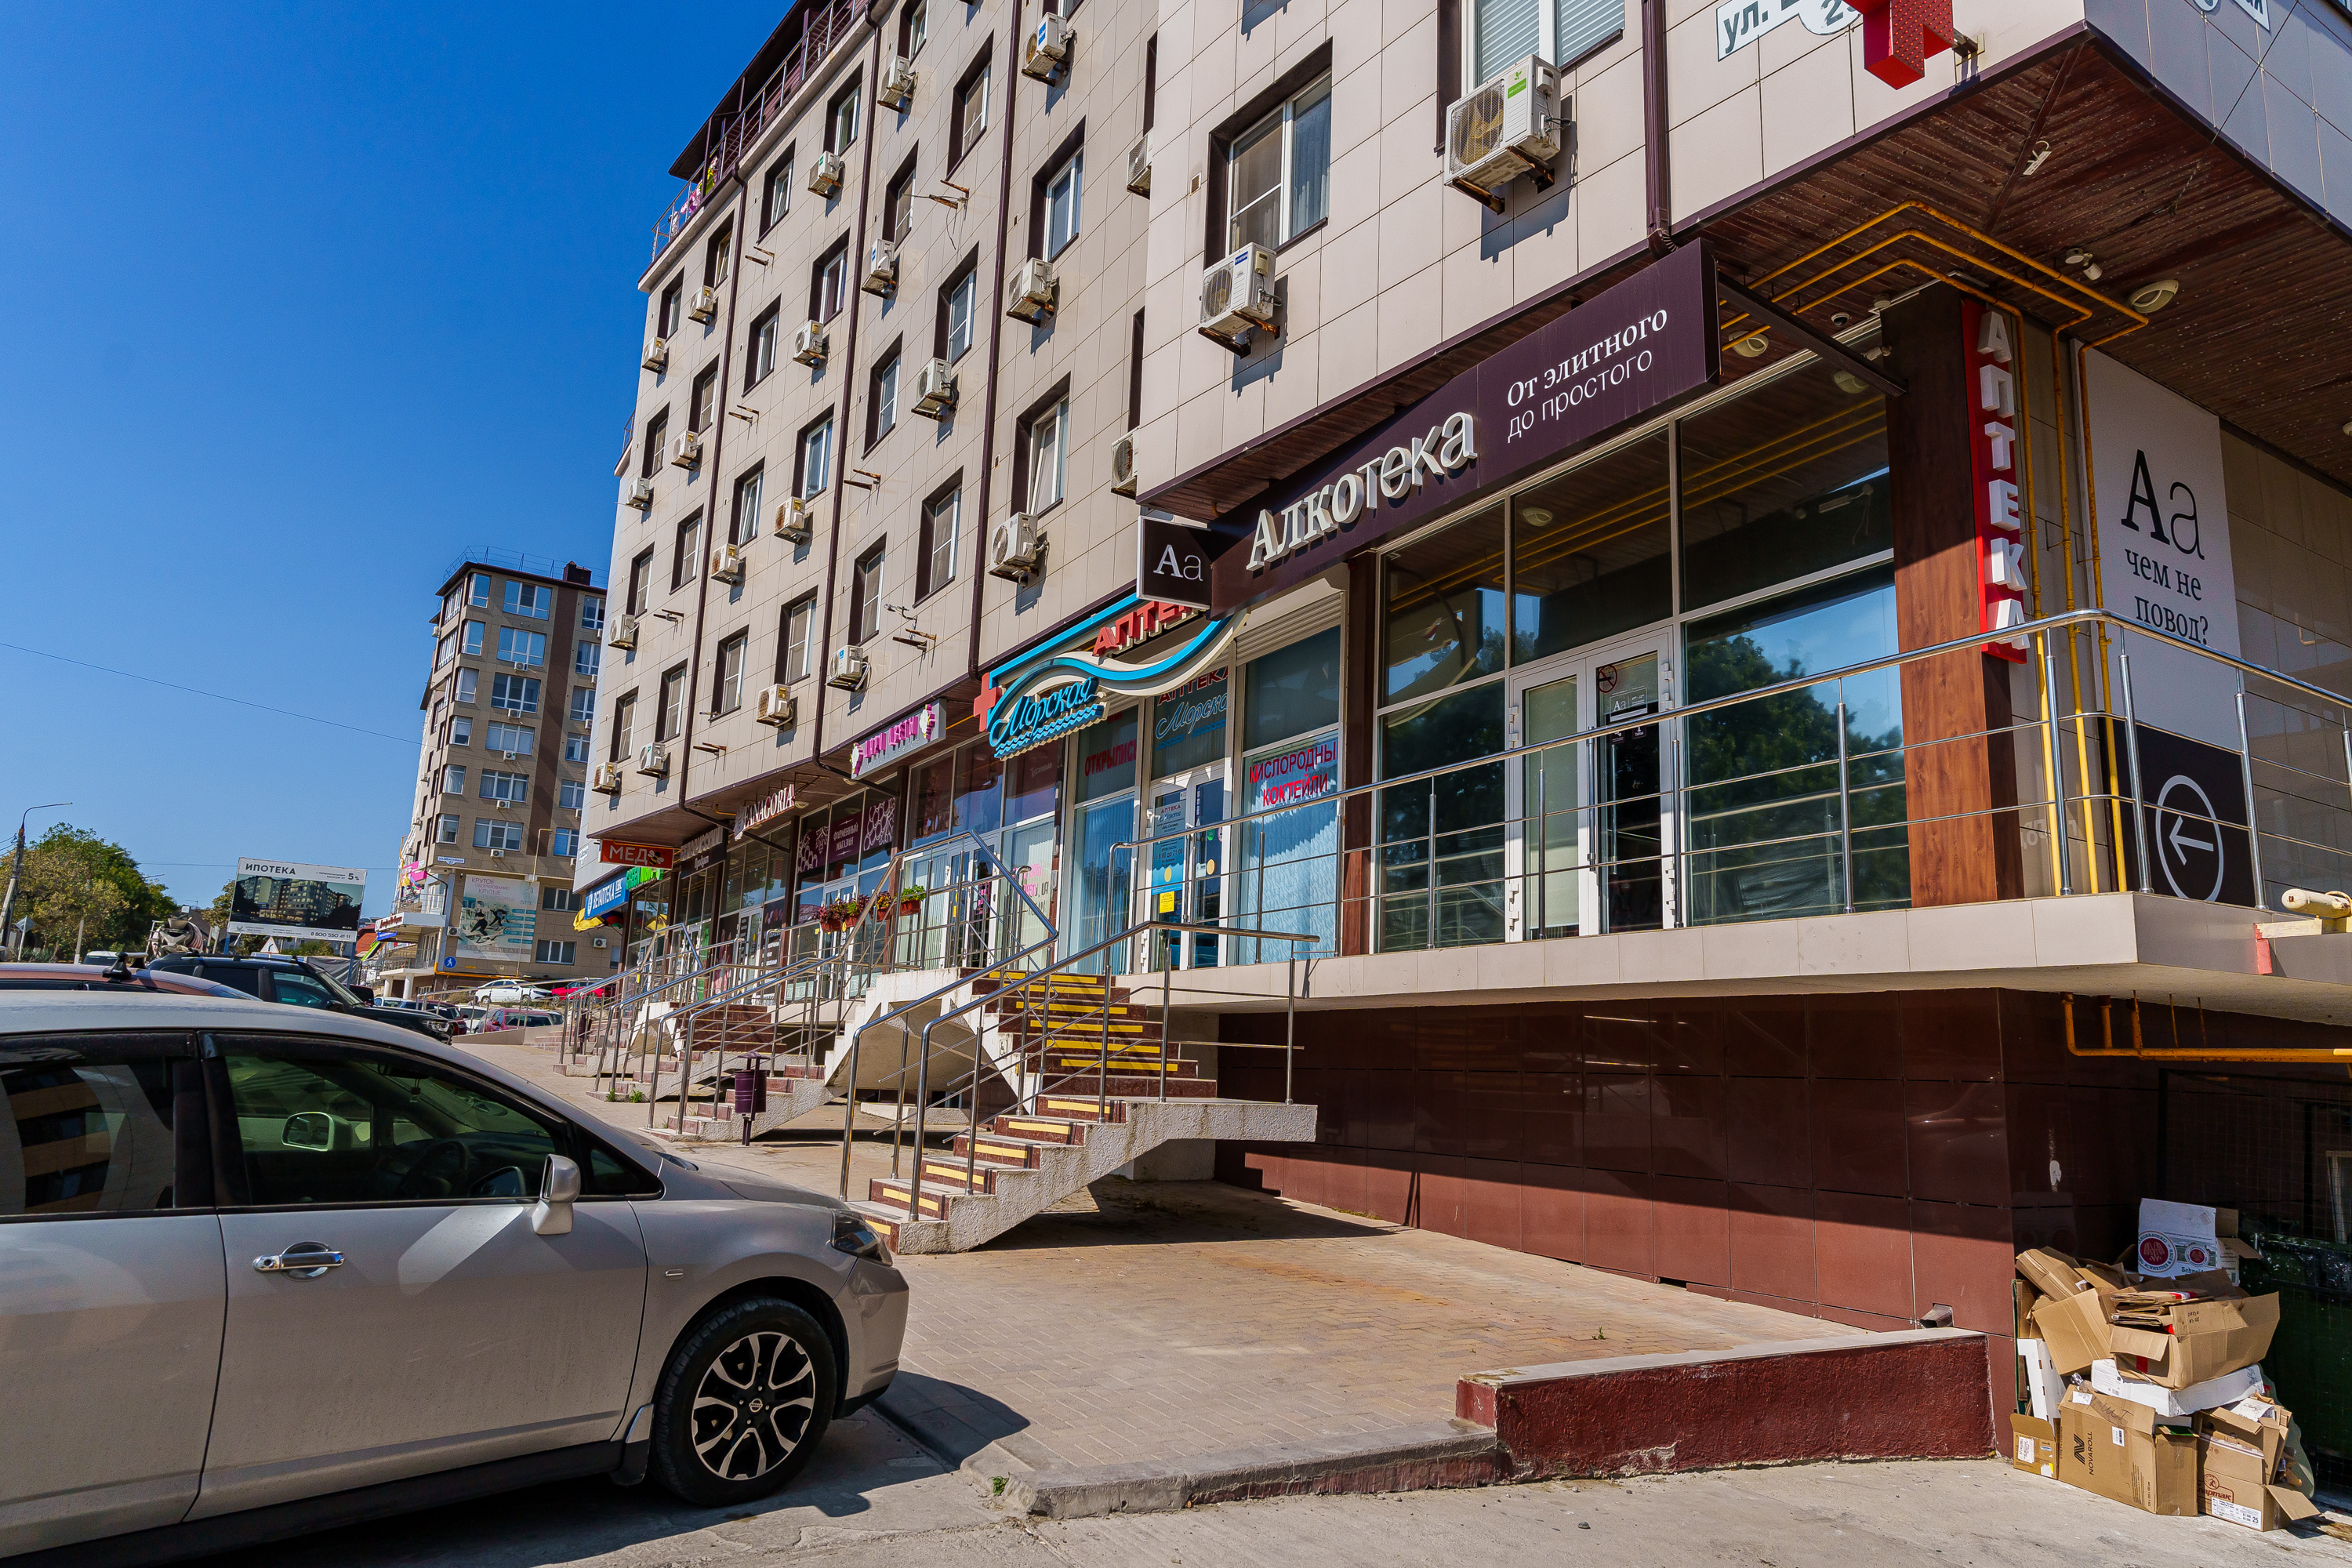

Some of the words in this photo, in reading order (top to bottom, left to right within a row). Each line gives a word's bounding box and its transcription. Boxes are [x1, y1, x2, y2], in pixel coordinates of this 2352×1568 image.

[1723, 1, 1769, 55] ул.
[1507, 376, 1537, 407] От
[1544, 309, 1668, 390] элитного
[1507, 409, 1534, 444] до
[1542, 350, 1653, 421] простого
[1246, 412, 1478, 572] Алкотека
[1976, 310, 2031, 651] АПТЕКА
[2124, 548, 2171, 590] чем
[2175, 568, 2202, 601] не
[1092, 601, 1192, 658] АПТЕ
[2134, 595, 2209, 645] повод?
[989, 677, 1098, 747] Морская
[742, 783, 796, 830] FANAGORIA
[1160, 804, 1181, 815] АПТЕКА
[1262, 772, 1328, 807] КОКТЕЙЛИ
[245, 862, 296, 876] ИПОТЕКА
[608, 844, 648, 866] МЕД
